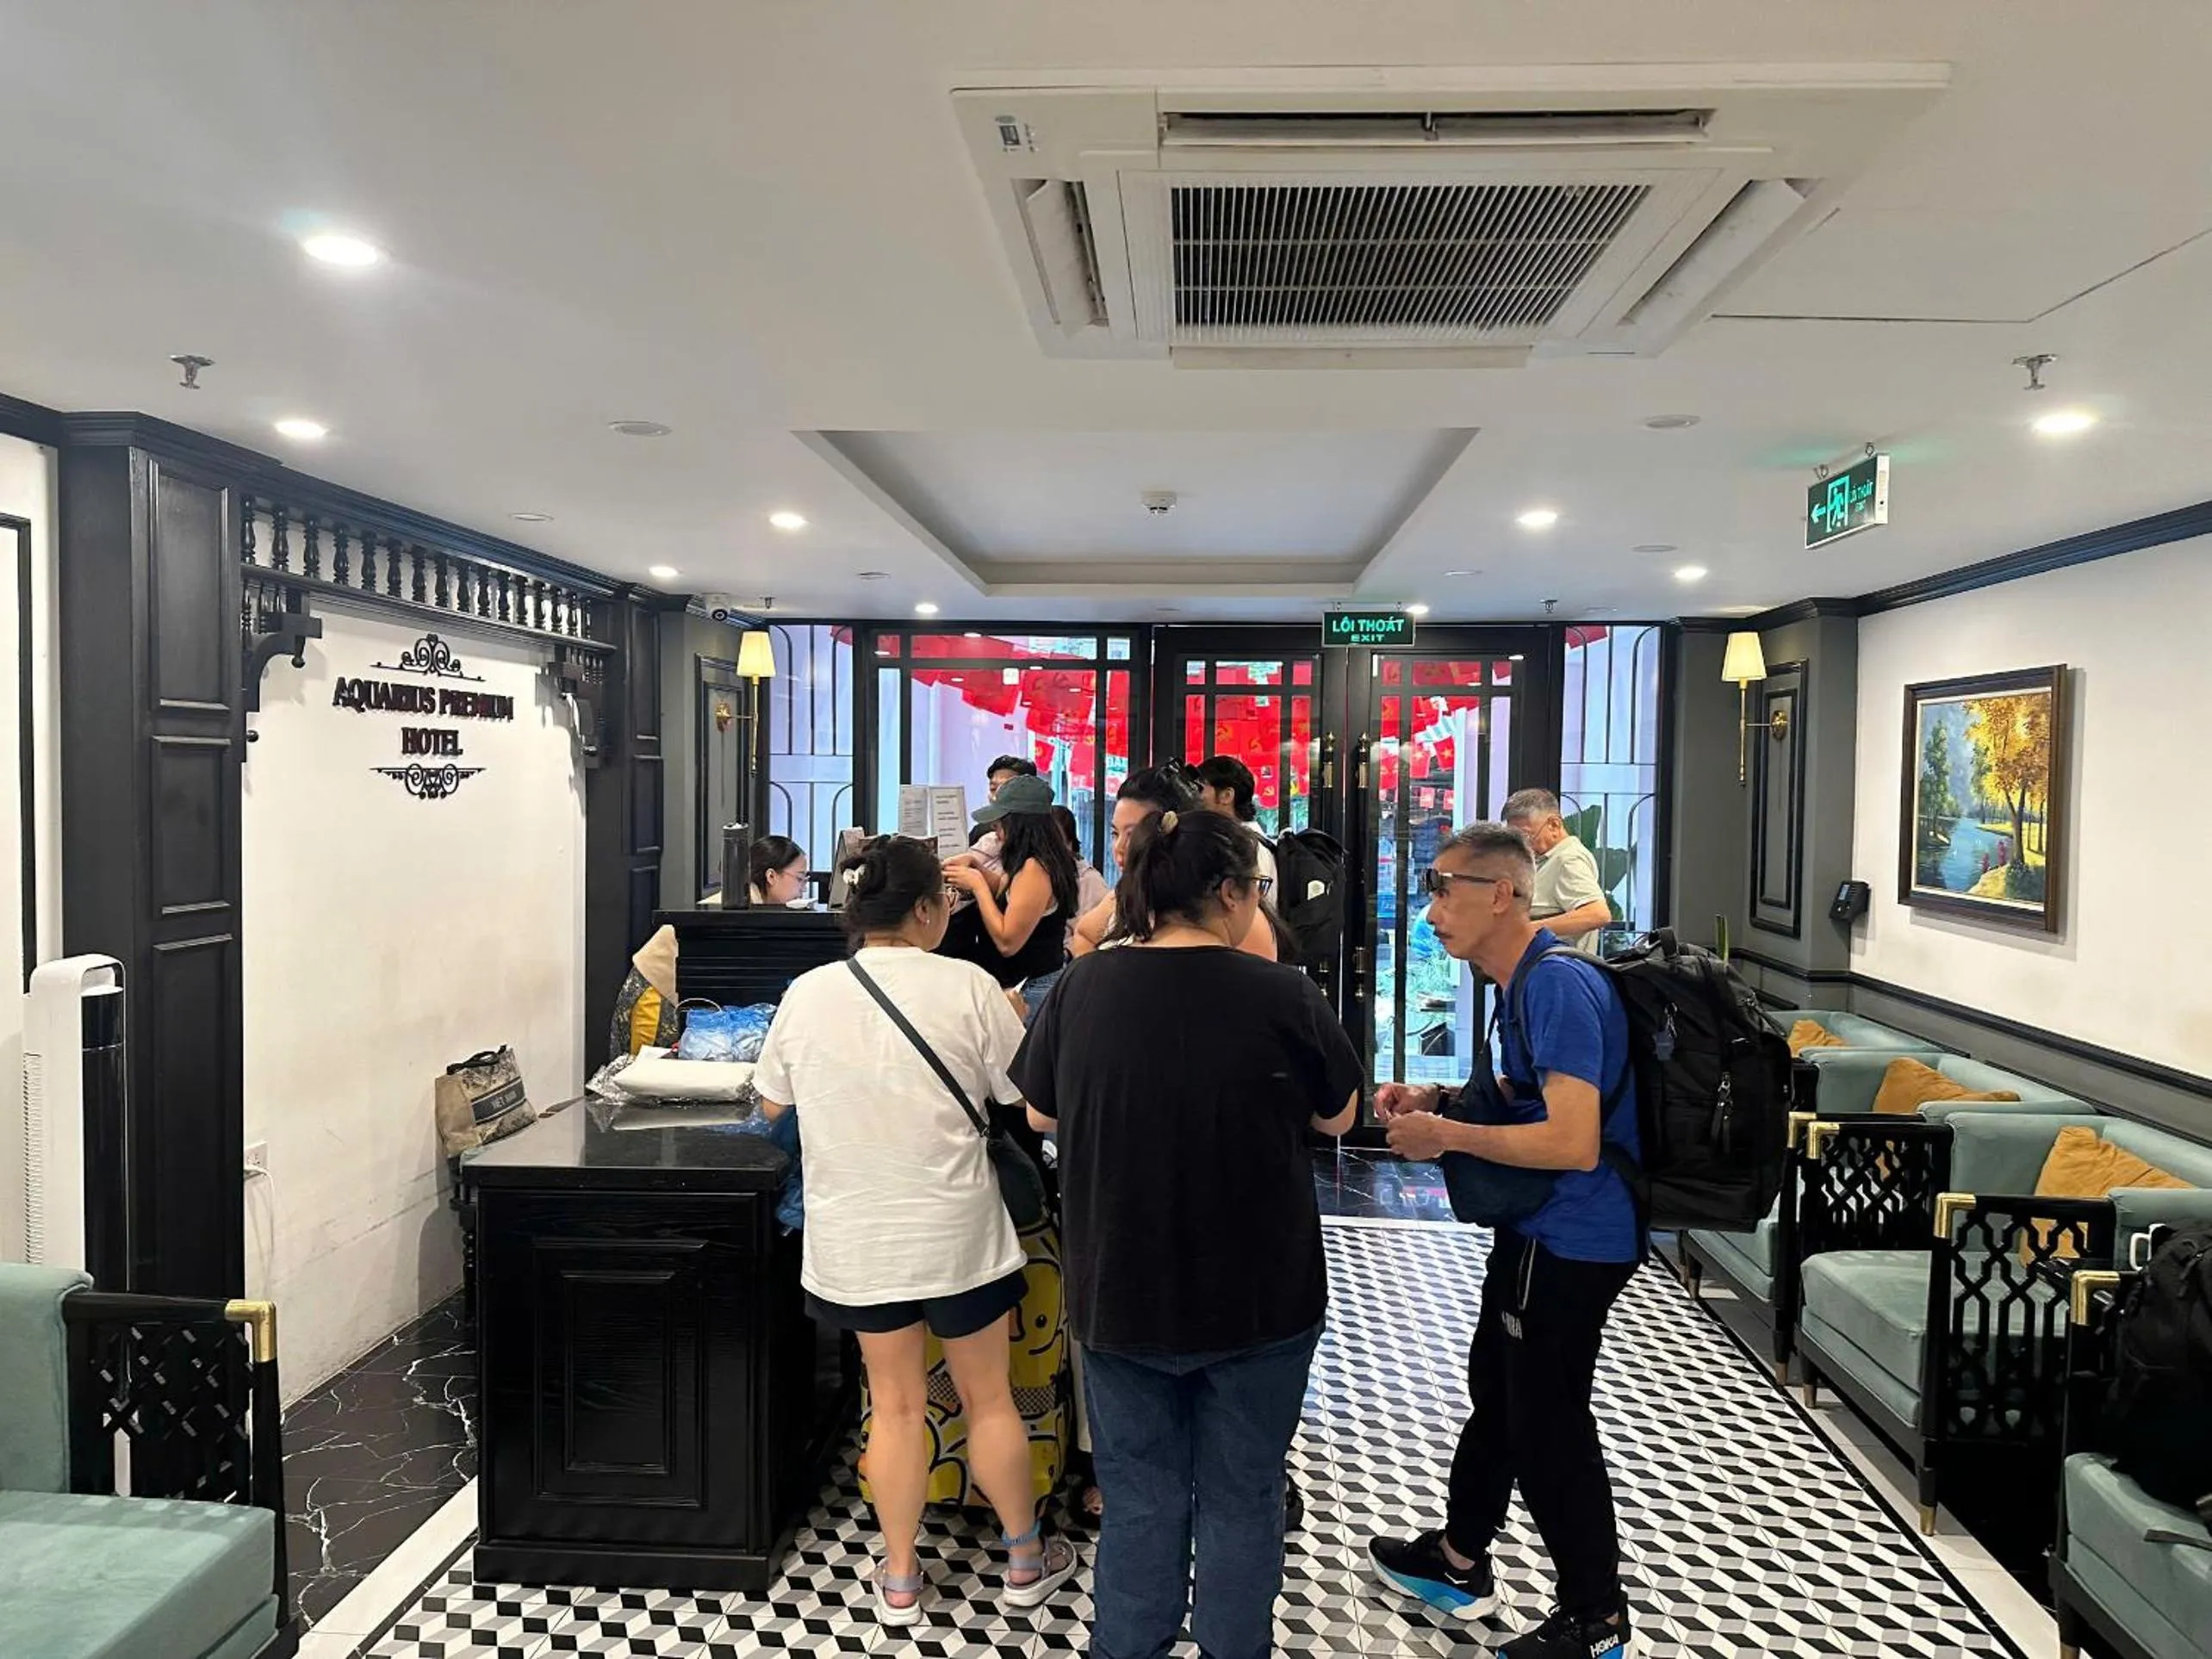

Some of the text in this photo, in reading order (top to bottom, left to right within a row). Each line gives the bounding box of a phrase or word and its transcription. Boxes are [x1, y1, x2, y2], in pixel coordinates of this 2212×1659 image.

[1358, 616, 1405, 632] THOÁT
[1351, 633, 1385, 643] EXIT
[332, 676, 514, 721] AQUARIUS PREMIUM
[401, 726, 463, 756] HOTEL
[1589, 1633, 1619, 1658] HOKA
